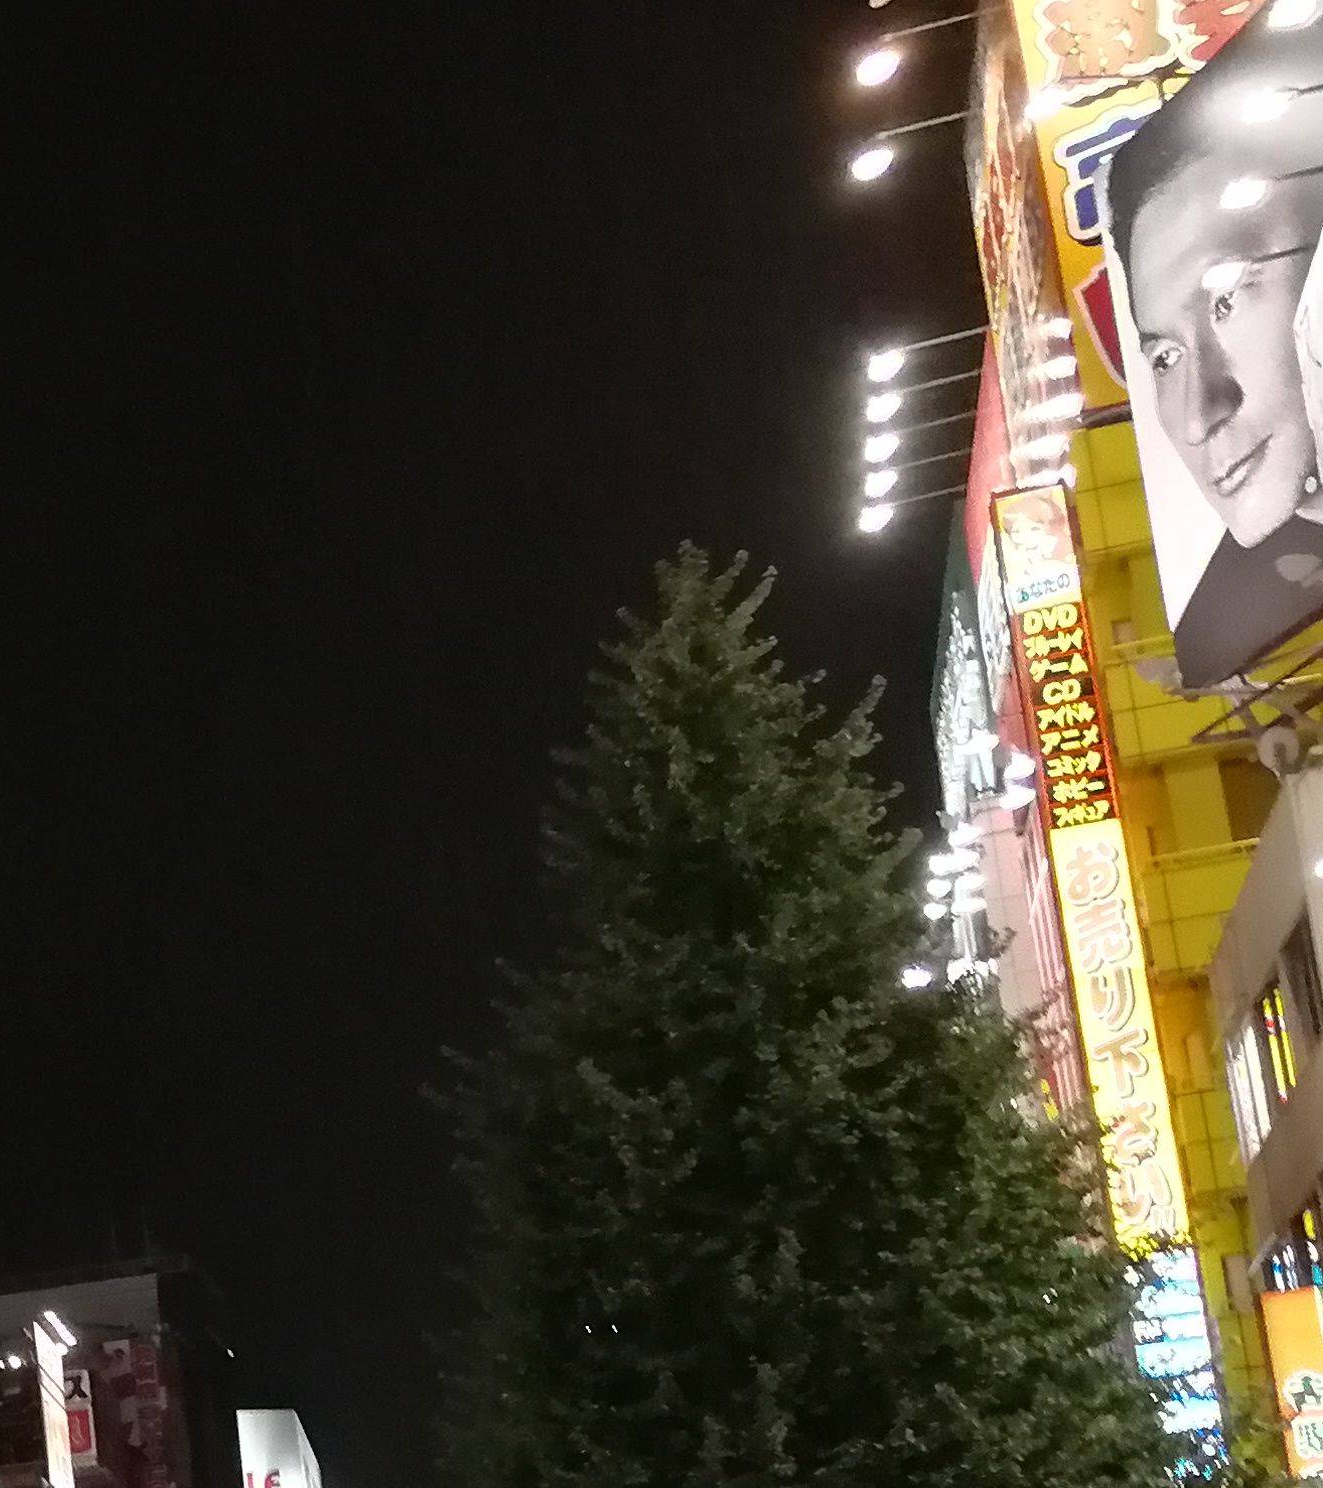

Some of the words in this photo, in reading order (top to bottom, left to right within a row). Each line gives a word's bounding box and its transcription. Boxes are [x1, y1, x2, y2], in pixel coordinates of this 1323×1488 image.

[1023, 603, 1078, 635] DVD
[1029, 652, 1089, 683] ゲーム
[1042, 678, 1081, 705] CD
[1040, 724, 1100, 756] アニメ
